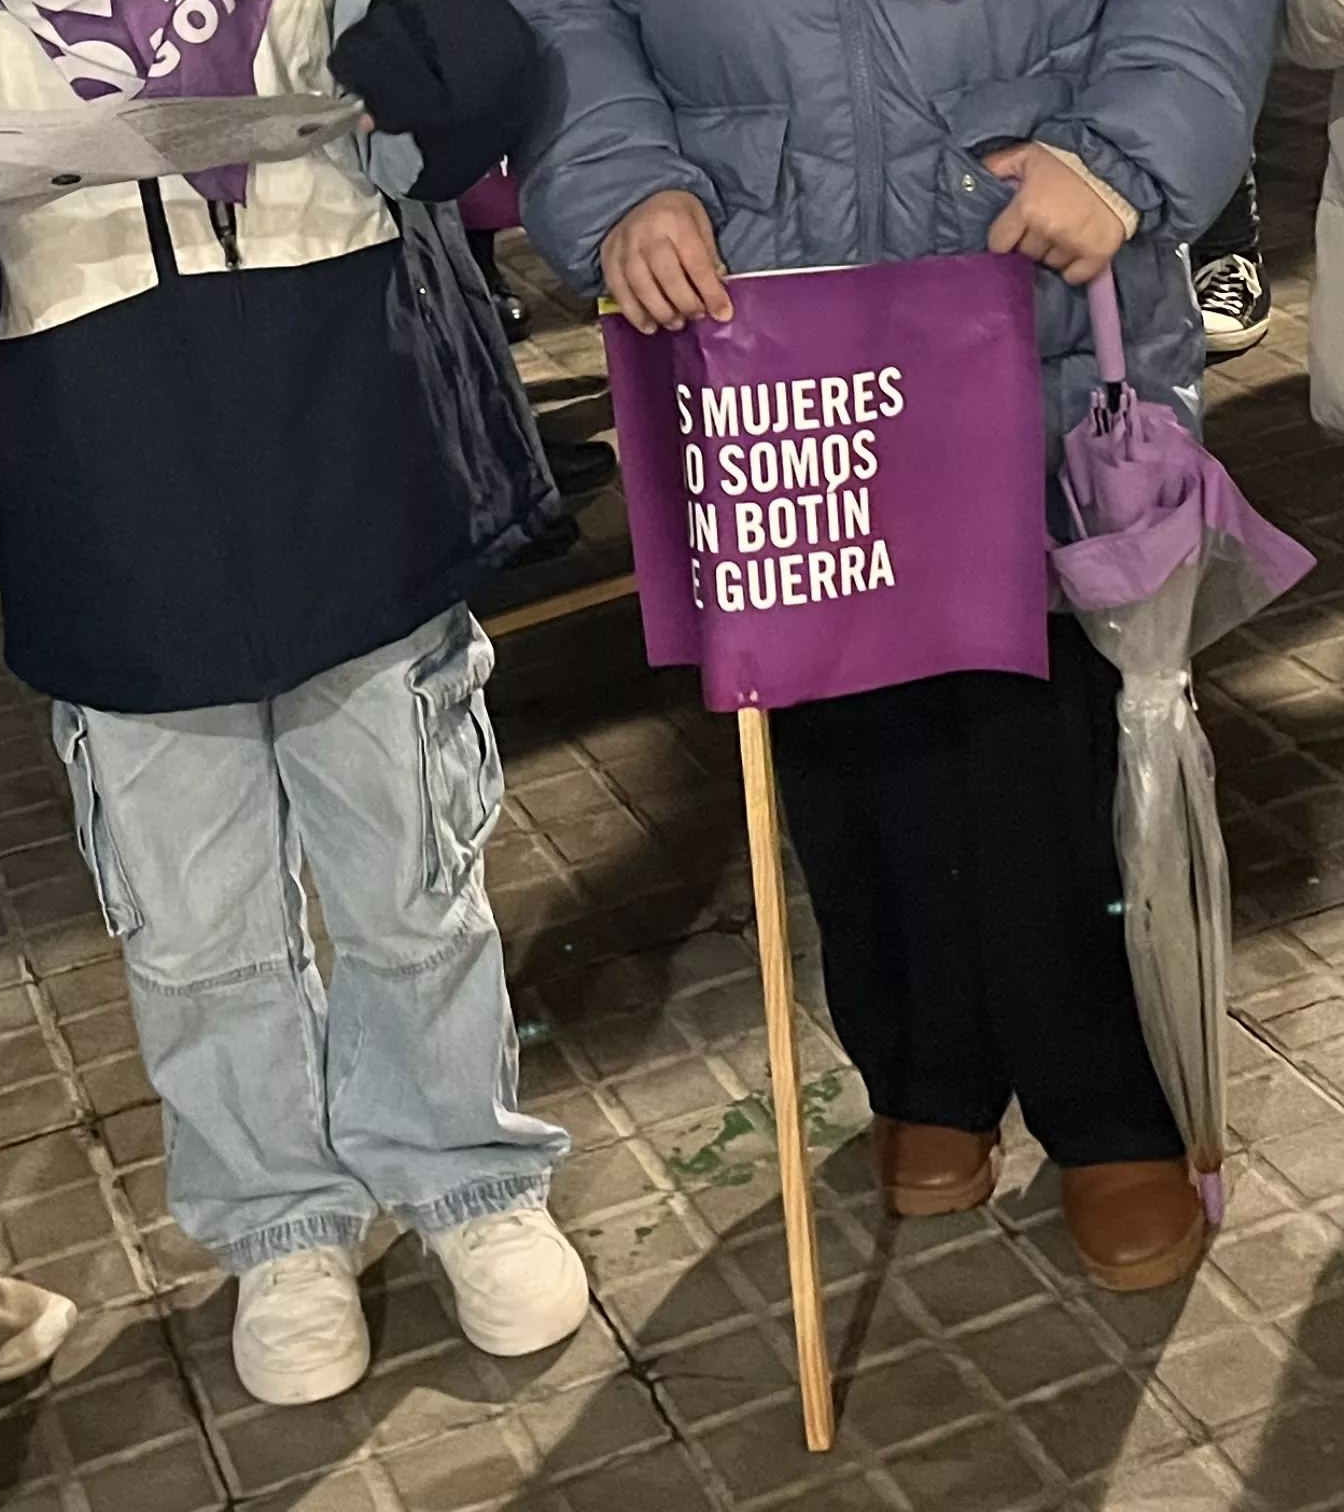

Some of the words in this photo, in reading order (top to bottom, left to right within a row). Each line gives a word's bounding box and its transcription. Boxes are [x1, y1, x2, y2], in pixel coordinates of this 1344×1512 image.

[702, 366, 905, 438] MUJERES
[718, 430, 879, 497] SOMOS
[735, 482, 871, 554] BOTÍN
[715, 539, 897, 613] GUERRA
